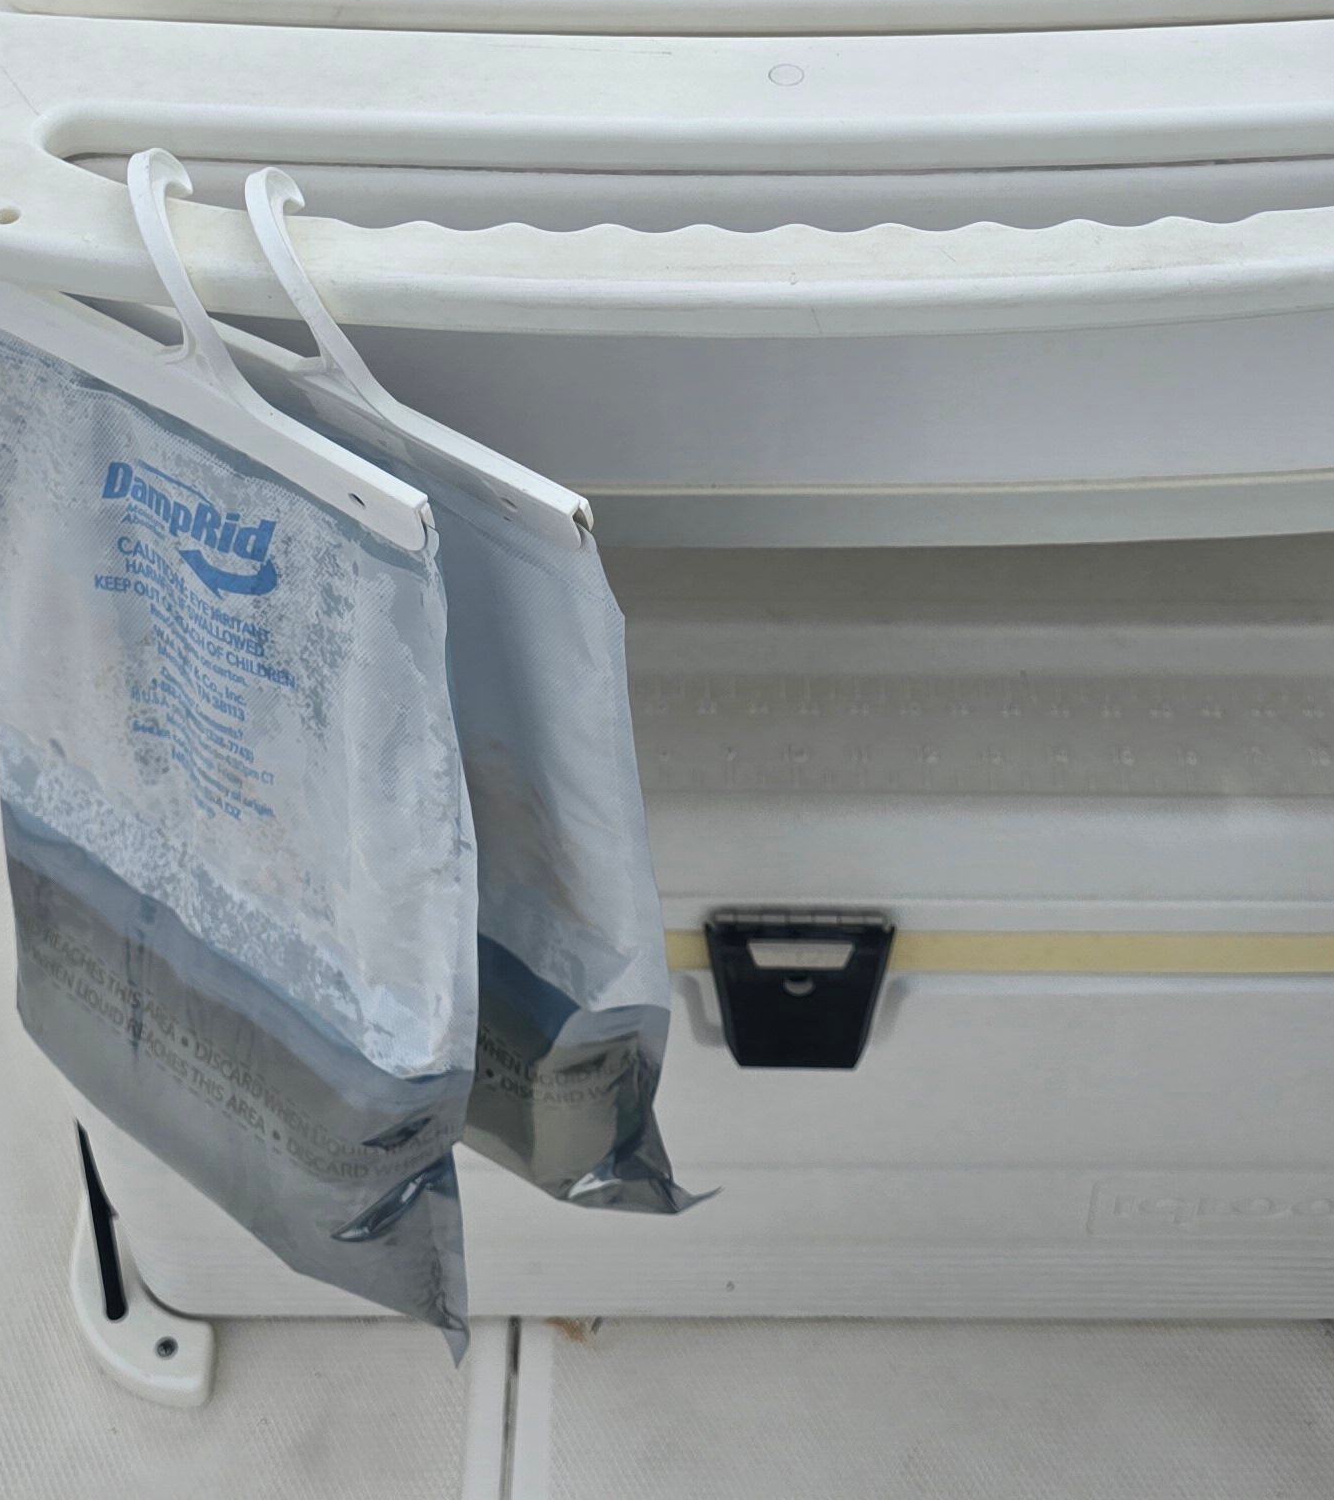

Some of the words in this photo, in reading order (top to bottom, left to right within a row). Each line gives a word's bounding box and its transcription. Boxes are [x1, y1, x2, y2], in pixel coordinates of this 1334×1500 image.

[101, 460, 277, 563] DampRid
[94, 573, 132, 592] KEEP
[133, 580, 161, 605] OUT
[207, 640, 225, 660] OF
[75, 976, 125, 1027] LIQUID
[190, 1065, 226, 1103] THIS
[225, 1094, 266, 1136] AREA
[285, 1135, 368, 1179] DISCARD
[107, 974, 143, 1010] THIS
[194, 1039, 264, 1100] DISCARD
